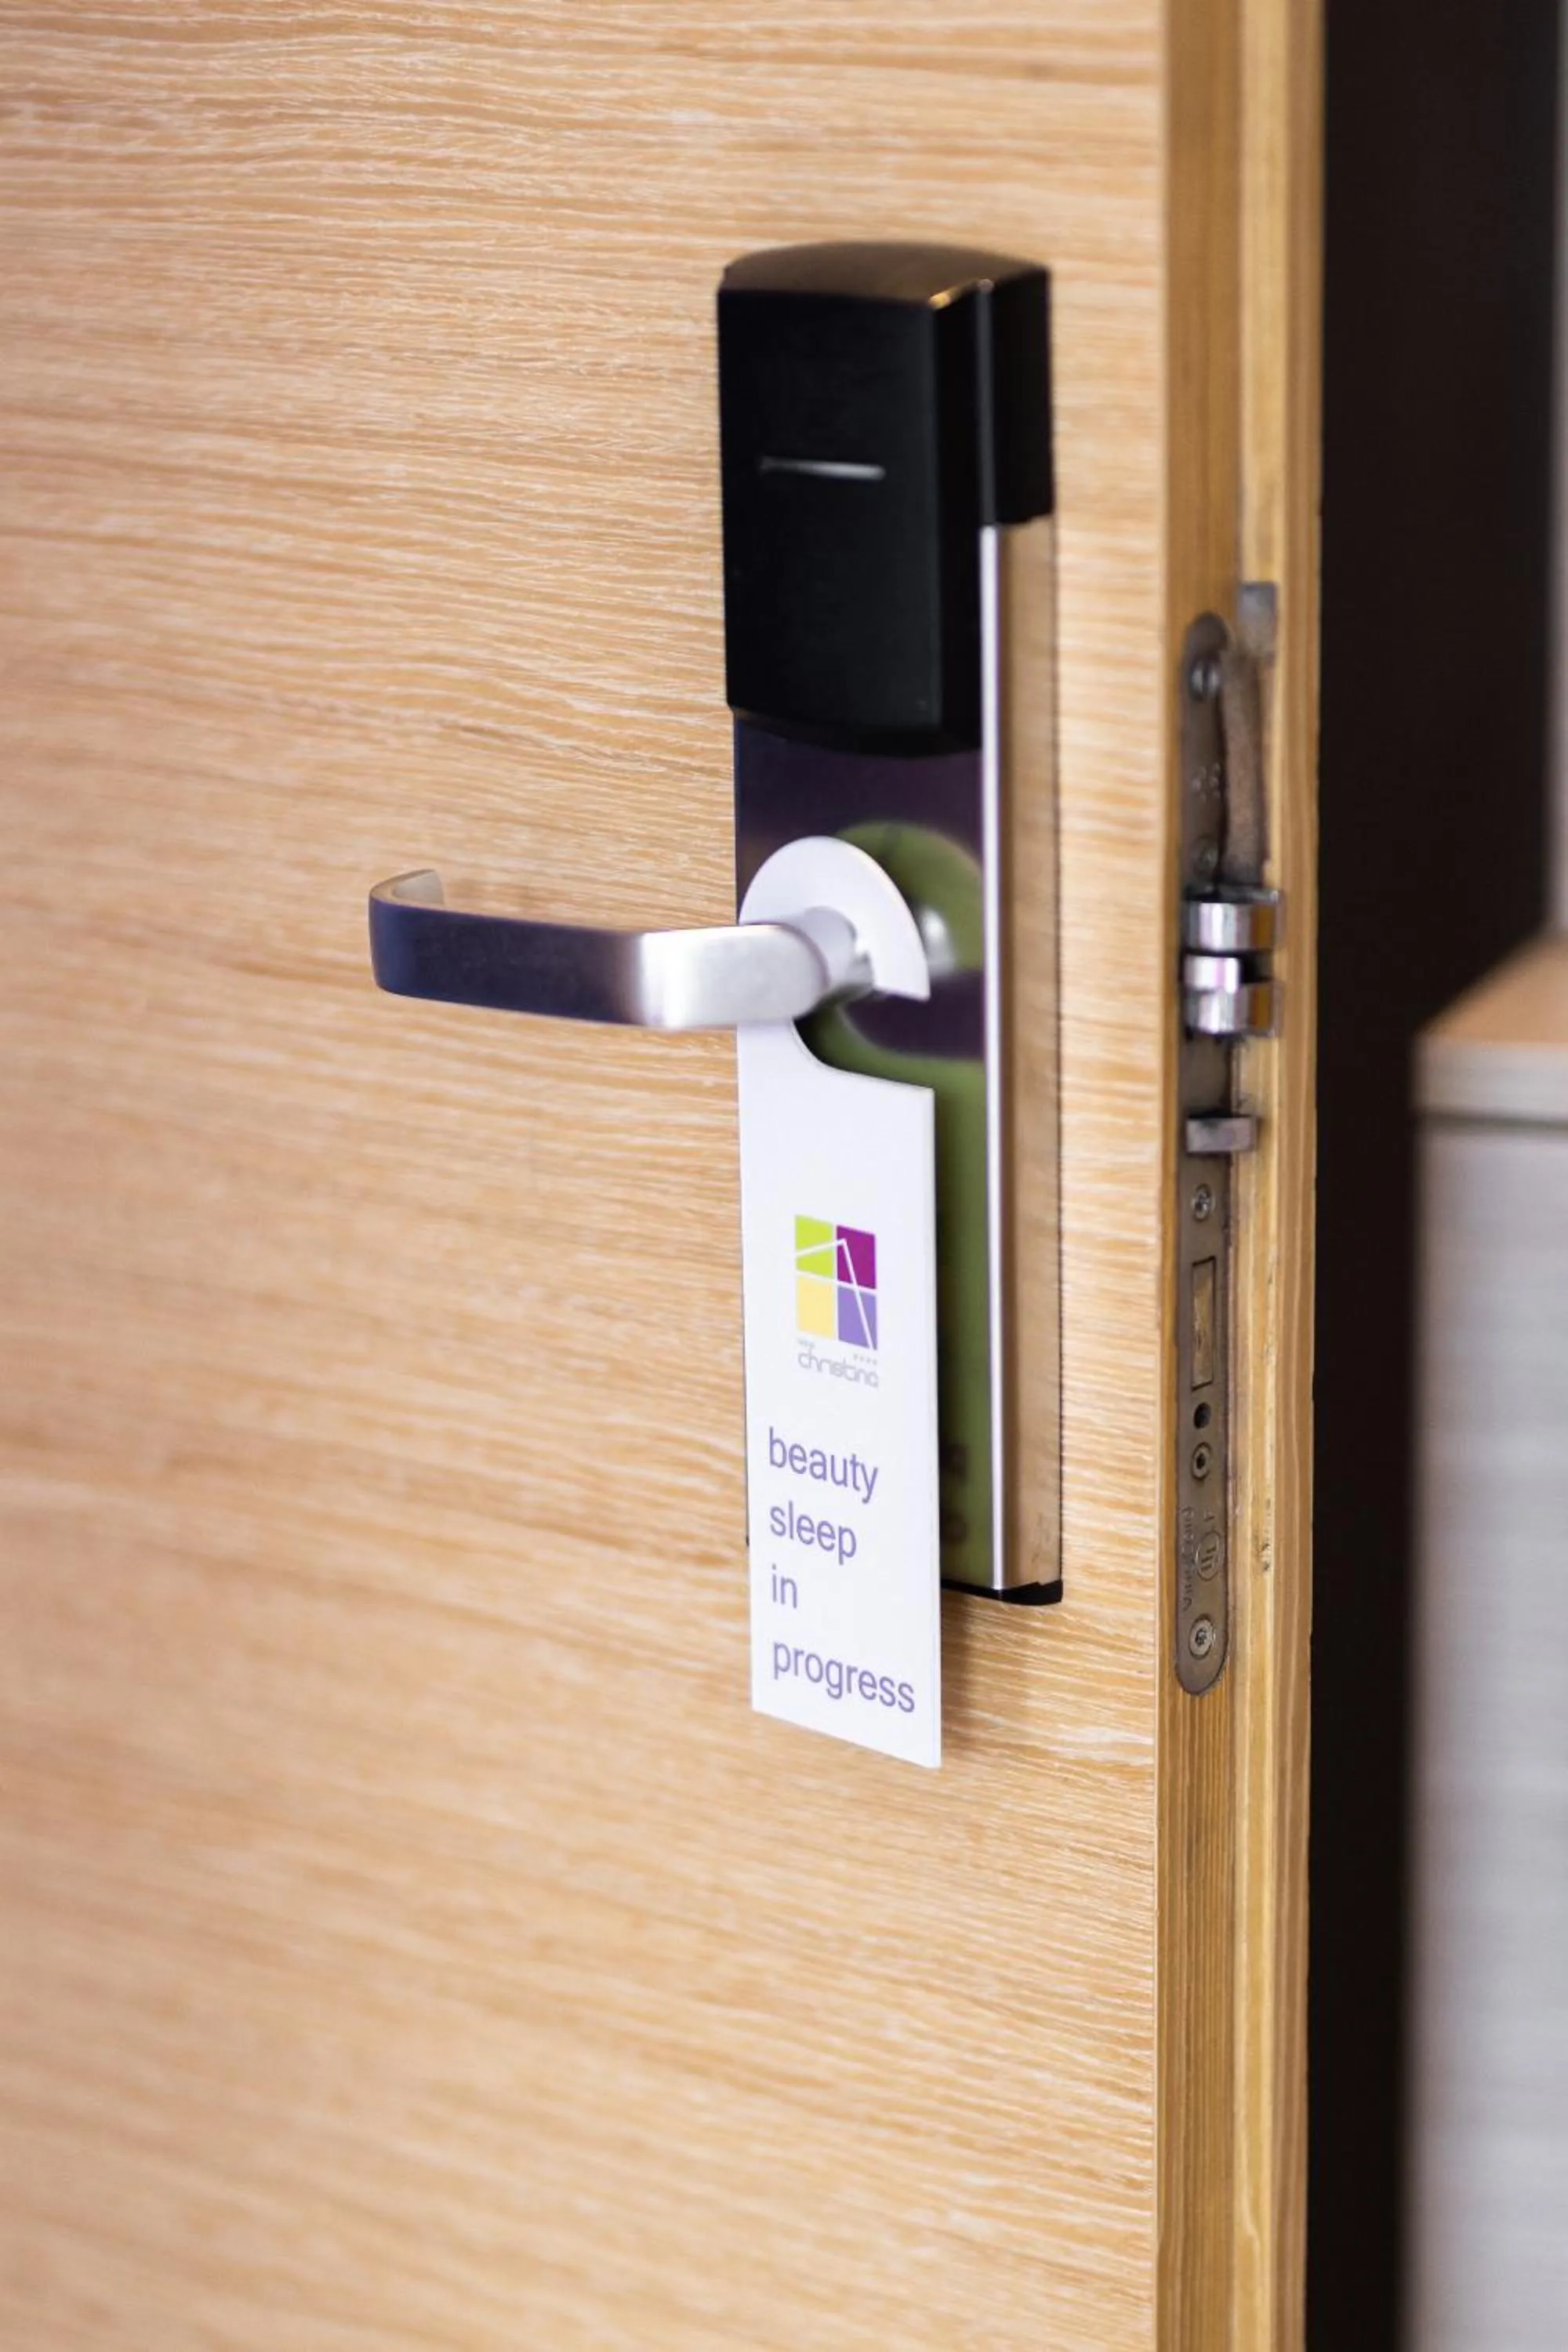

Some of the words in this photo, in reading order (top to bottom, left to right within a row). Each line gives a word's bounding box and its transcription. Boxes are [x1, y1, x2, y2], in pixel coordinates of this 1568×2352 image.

[768, 1426, 879, 1504] beauty
[769, 1501, 857, 1566] sleep
[771, 1563, 798, 1610] in
[773, 1641, 916, 1714] progress
